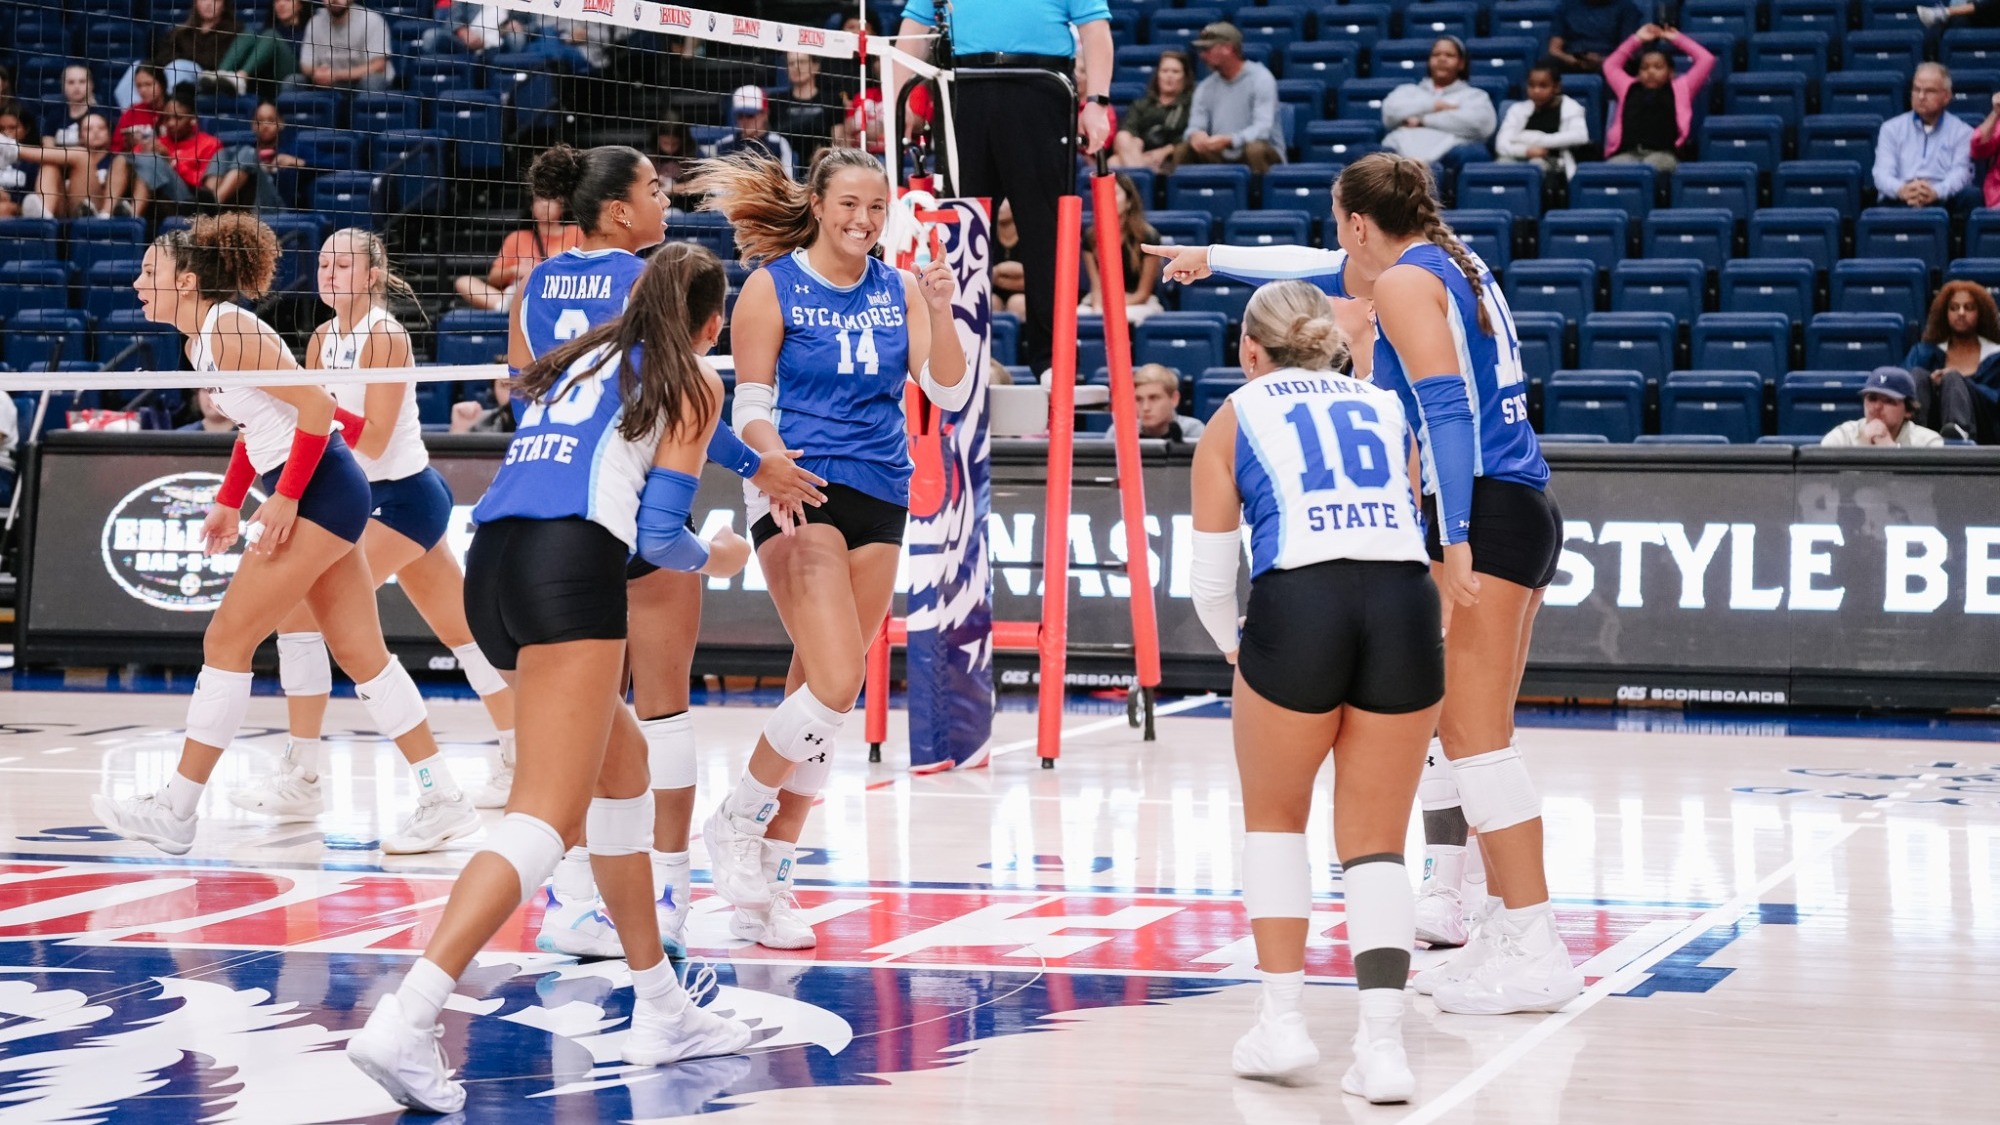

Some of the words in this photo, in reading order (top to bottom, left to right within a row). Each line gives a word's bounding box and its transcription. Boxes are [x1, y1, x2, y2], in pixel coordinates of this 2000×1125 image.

[660, 7, 691, 27] BRUINS
[541, 275, 613, 299] INDIANA
[791, 306, 904, 330] SYCAMORES
[835, 328, 879, 375] 14
[1264, 379, 1369, 397] INDIANA
[505, 433, 579, 466] STATE
[1284, 401, 1391, 493] 16
[1308, 503, 1399, 532] STATE
[1543, 520, 1845, 610] STYLE
[1651, 688, 1786, 704] SCOREBOARDS
